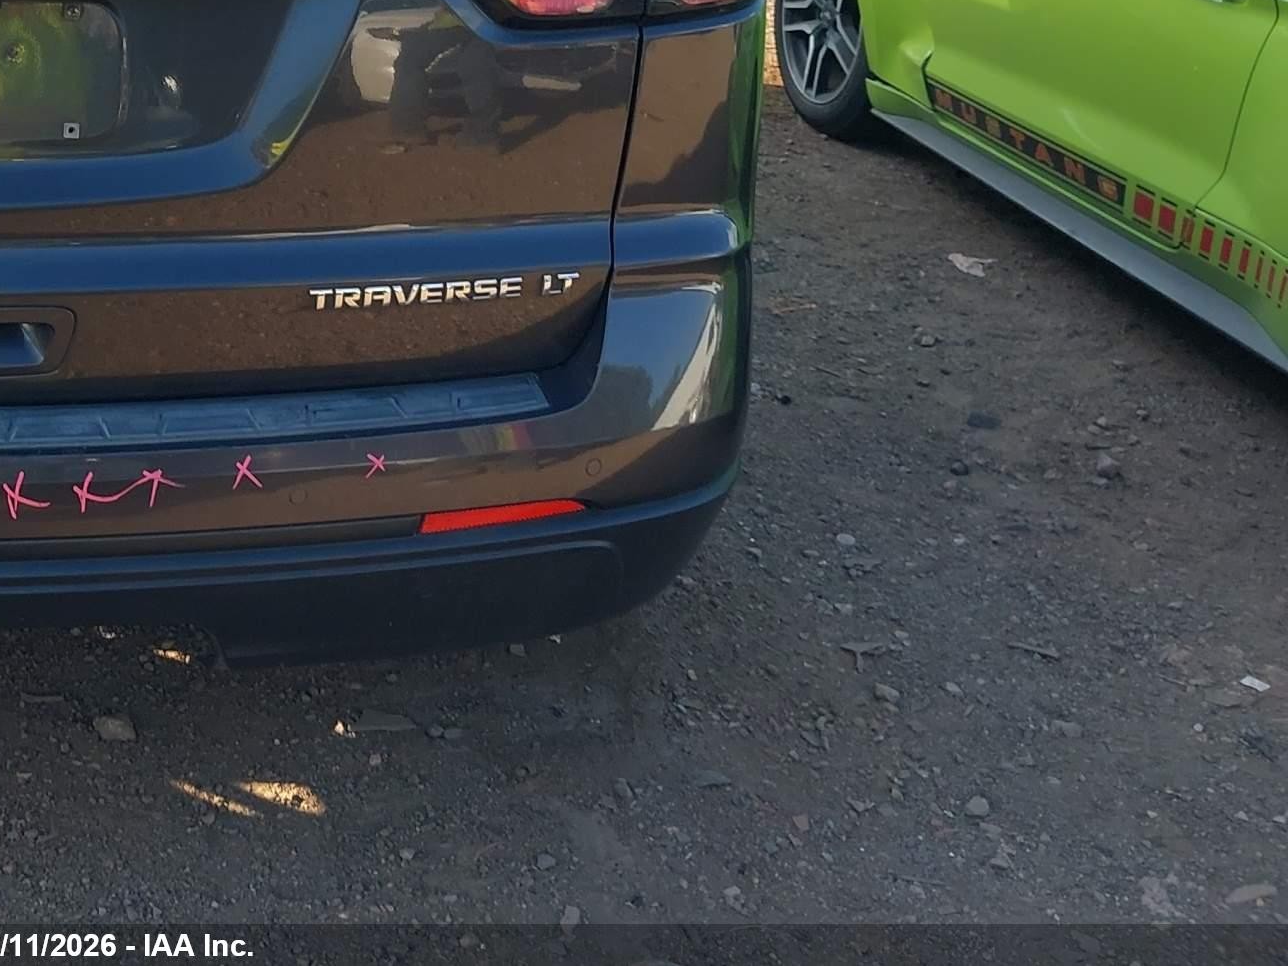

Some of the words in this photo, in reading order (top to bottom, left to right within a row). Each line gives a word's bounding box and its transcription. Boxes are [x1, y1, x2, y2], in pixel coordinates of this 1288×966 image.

[934, 88, 1121, 202] MUSTANG
[309, 276, 523, 311] TRAVERSE
[542, 272, 580, 296] LT
